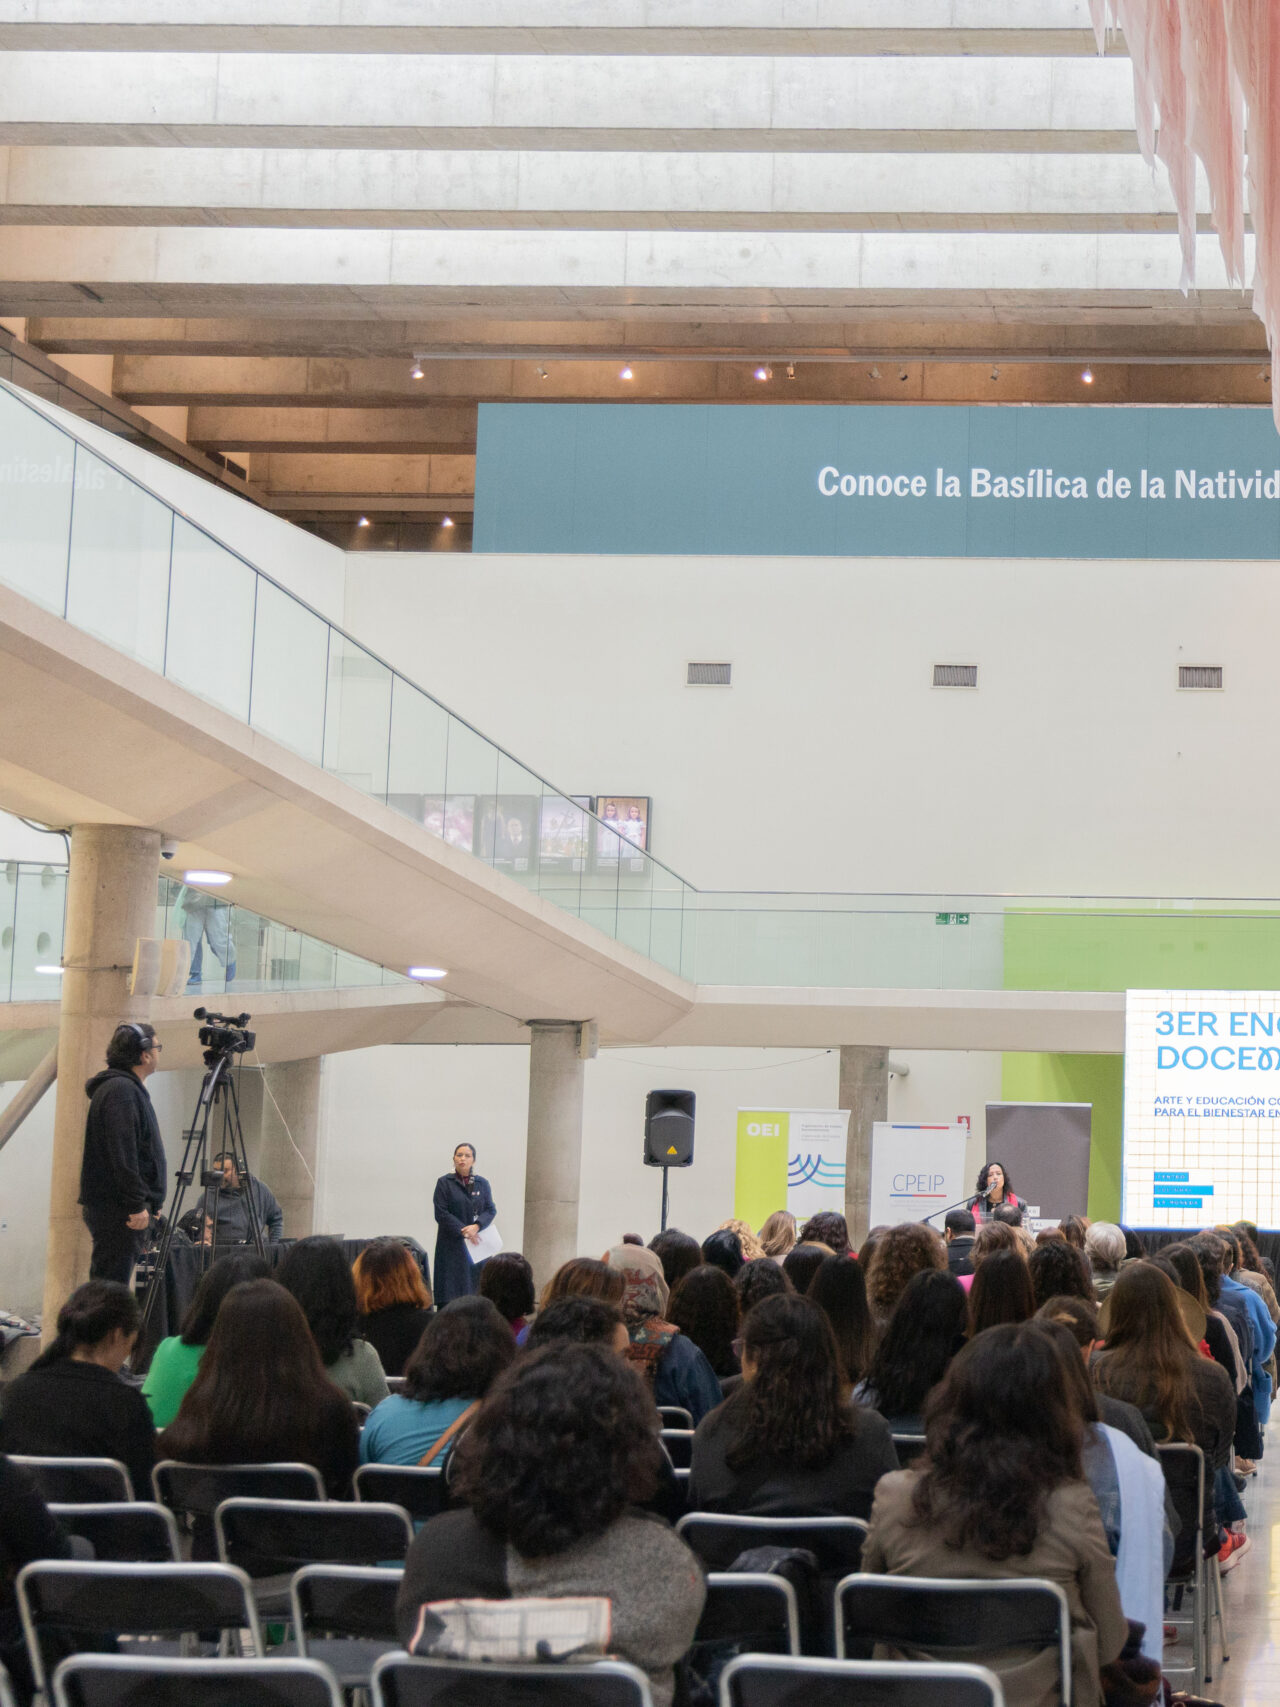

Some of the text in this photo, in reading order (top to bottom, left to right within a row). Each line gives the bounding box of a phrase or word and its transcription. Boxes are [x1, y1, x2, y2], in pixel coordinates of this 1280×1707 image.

[817, 466, 927, 497] Conoce
[936, 467, 962, 498] la
[970, 468, 1089, 499] Basílica
[1096, 469, 1132, 499] de
[1140, 469, 1166, 499] la
[1155, 1011, 1219, 1036] 3ER
[1154, 1096, 1183, 1105] ARTE
[1185, 1096, 1193, 1105] Y
[1196, 1095, 1265, 1106] EDUCACIÓN
[1154, 1108, 1185, 1117] PARA
[1188, 1108, 1201, 1117] EL
[1203, 1109, 1266, 1118] BIENESTAR
[747, 1122, 780, 1137] OEI
[892, 1173, 945, 1192] CPEIP
